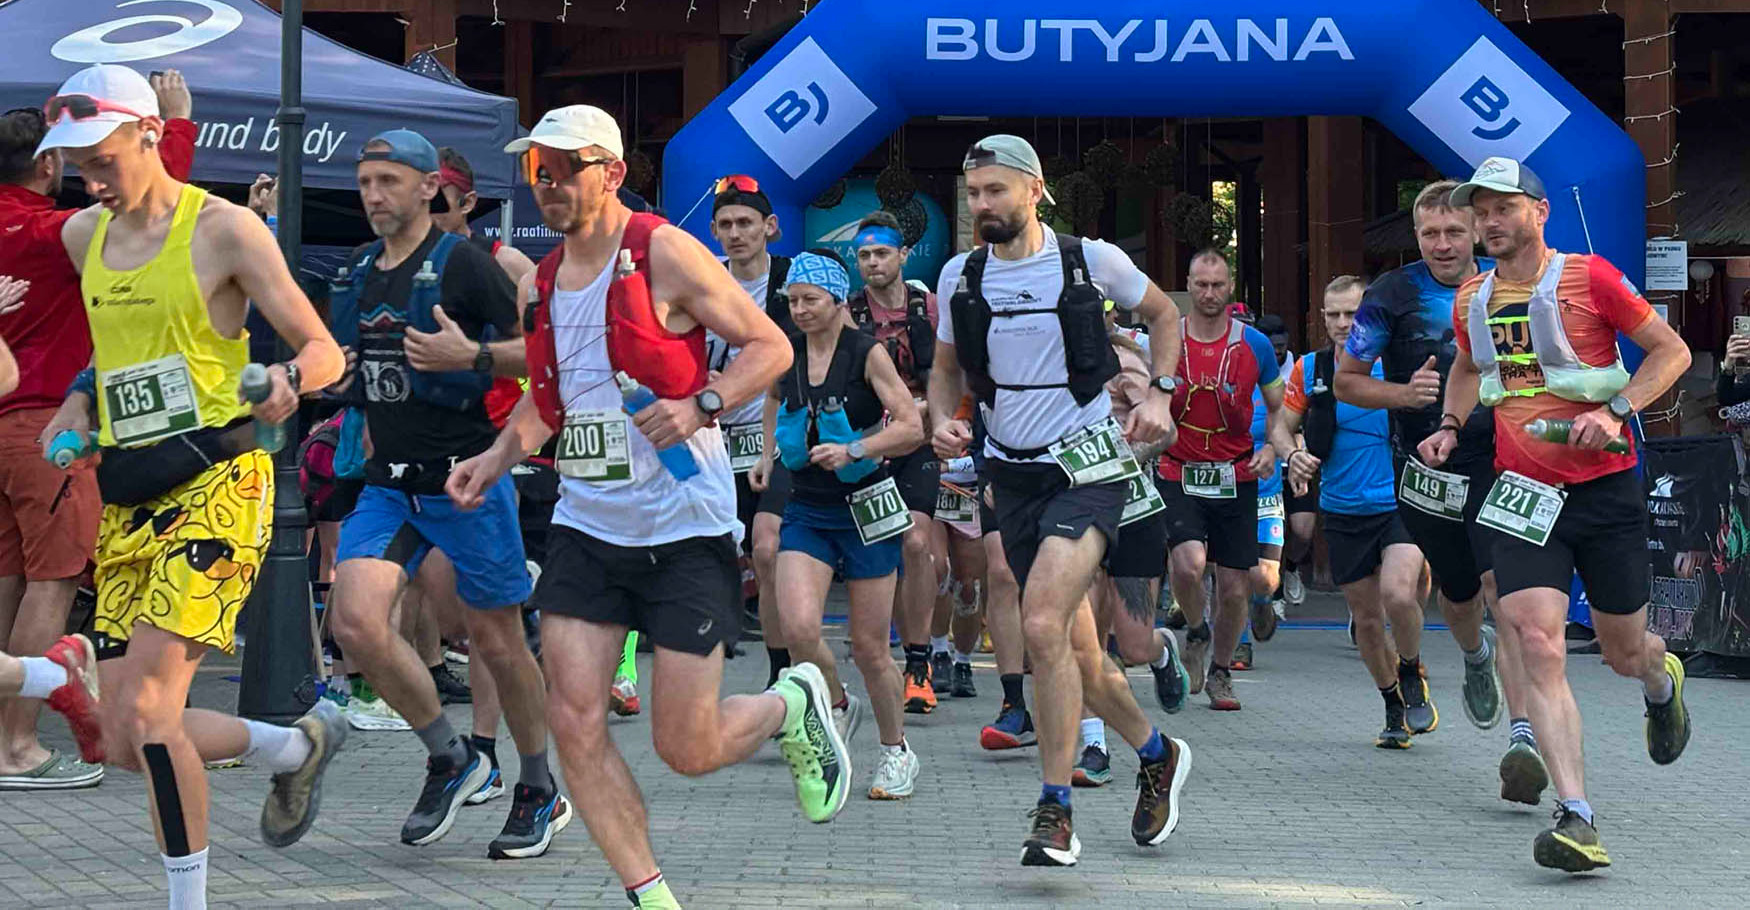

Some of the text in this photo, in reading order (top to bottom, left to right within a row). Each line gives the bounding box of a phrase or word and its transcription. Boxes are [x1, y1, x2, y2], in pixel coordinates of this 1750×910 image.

[926, 17, 1355, 62] BUTYJANA
[259, 118, 347, 162] bdy
[115, 379, 155, 416] 135
[563, 425, 600, 457] 200
[739, 433, 764, 455] 209
[1073, 434, 1111, 466] 194
[1193, 469, 1216, 484] 127
[1414, 472, 1440, 498] 149
[864, 491, 898, 520] 170
[1496, 483, 1532, 514] 221
